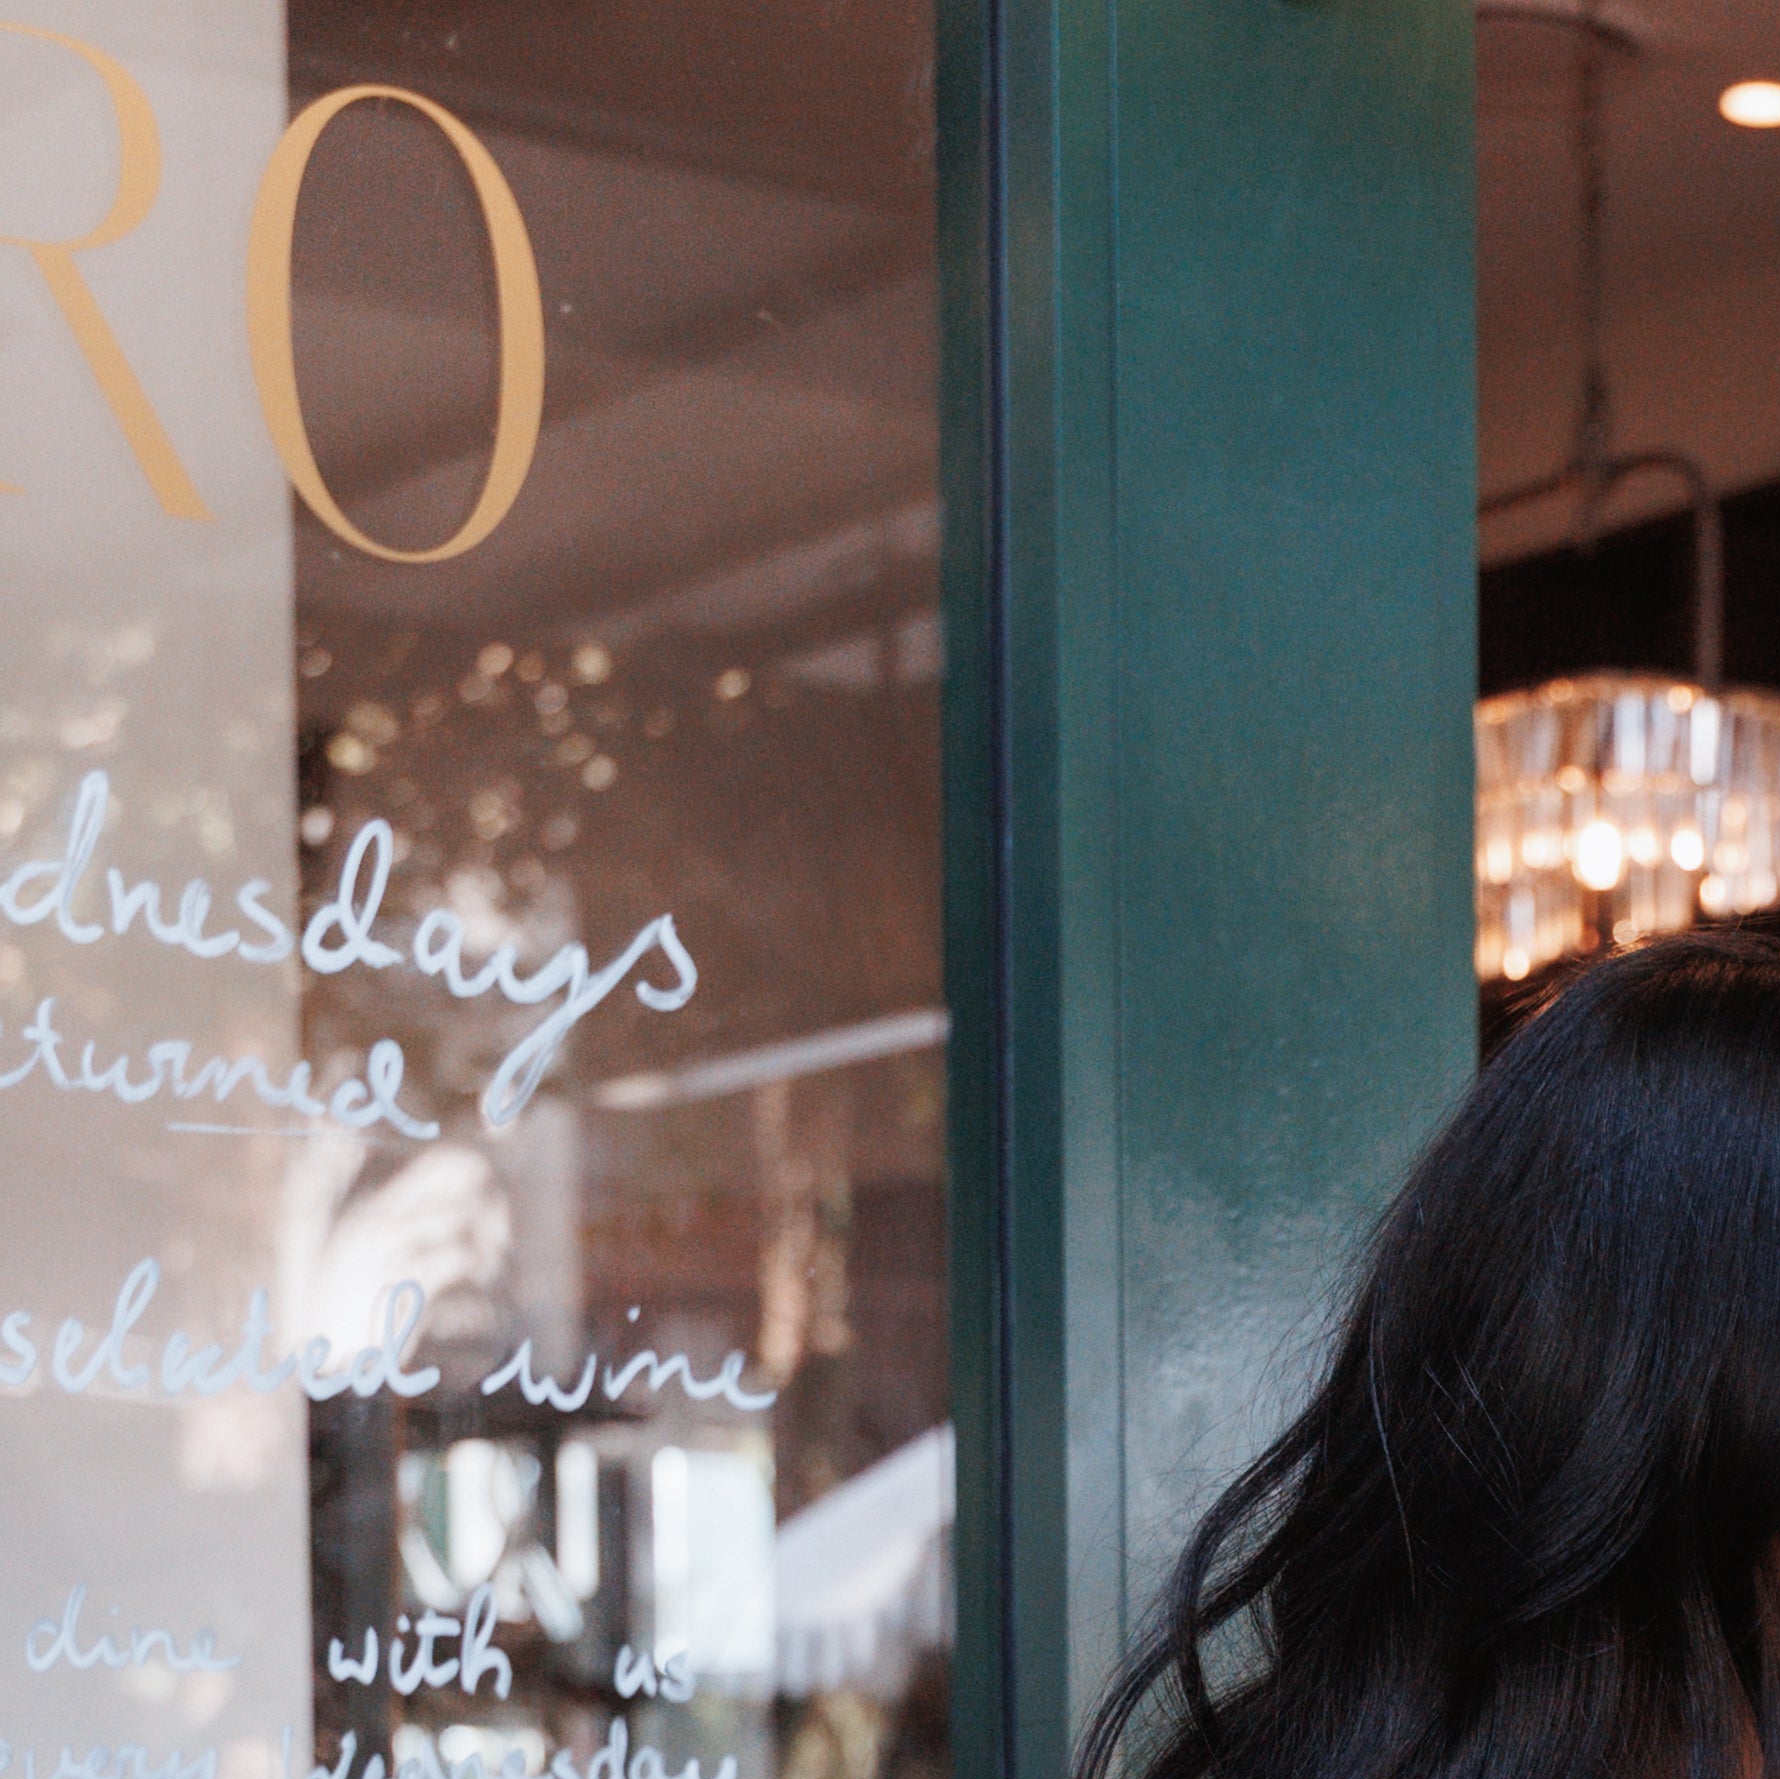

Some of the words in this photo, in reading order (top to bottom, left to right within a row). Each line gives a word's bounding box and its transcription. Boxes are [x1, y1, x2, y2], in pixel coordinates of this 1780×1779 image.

[0, 22, 545, 563] RO
[0, 1256, 441, 1400] selected
[482, 1306, 777, 1412] wine
[25, 1583, 243, 1673] dine
[328, 1582, 513, 1700] with
[614, 1643, 697, 1703] us
